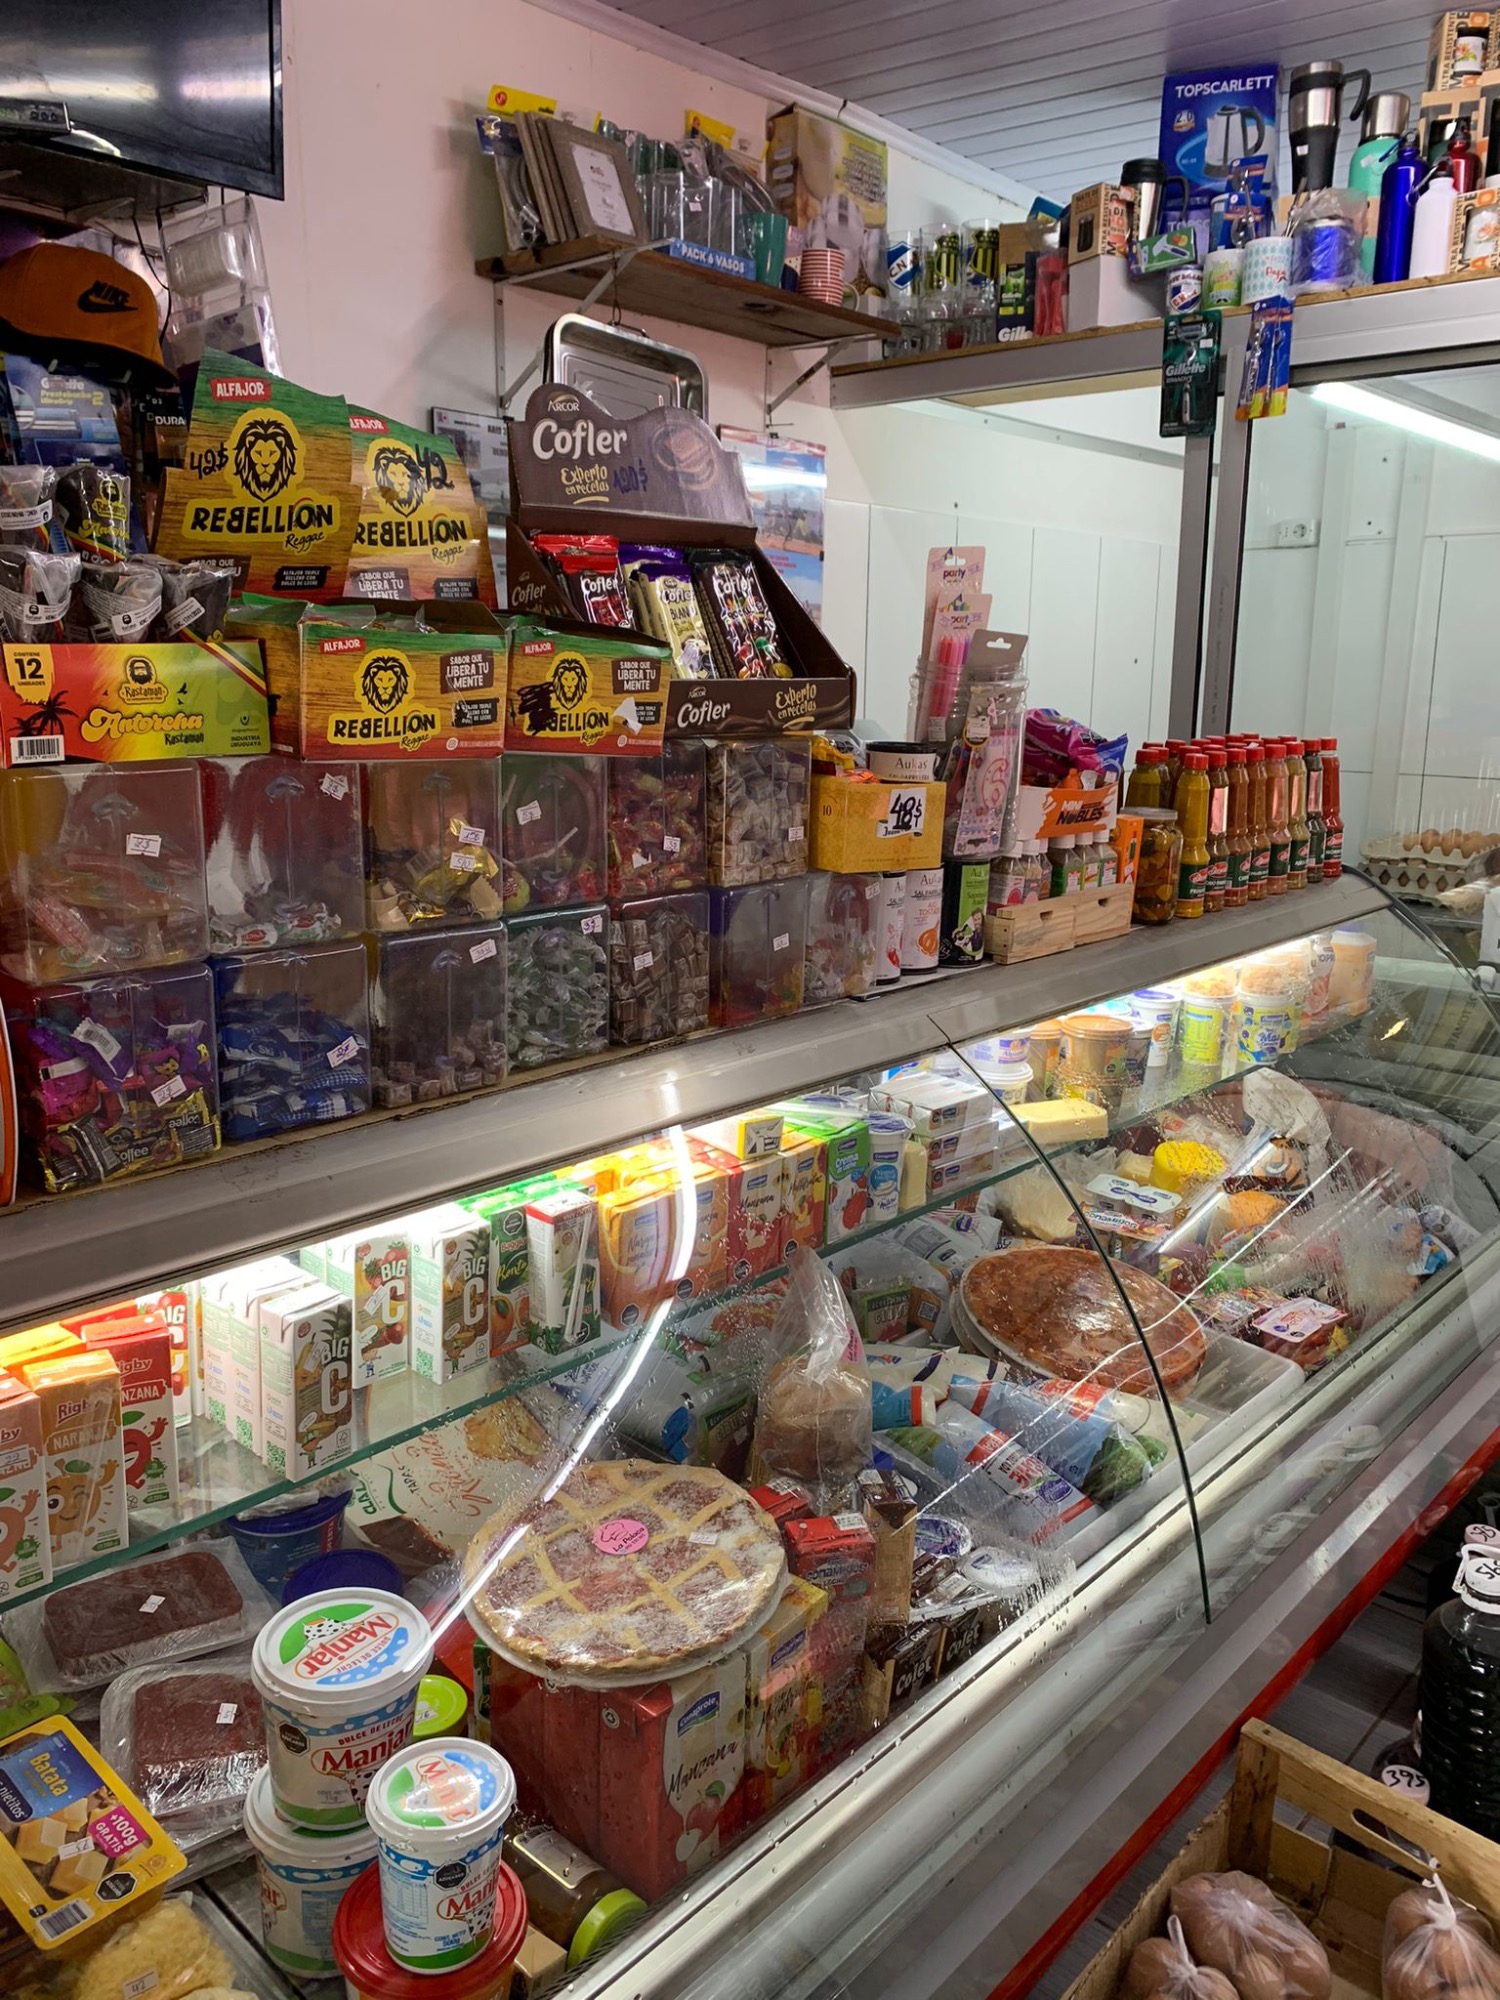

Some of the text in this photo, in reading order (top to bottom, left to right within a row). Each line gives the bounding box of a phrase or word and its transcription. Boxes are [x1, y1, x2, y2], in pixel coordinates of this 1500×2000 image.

[1175, 75, 1273, 98] TOPSCARLETT
[682, 245, 745, 273] PACK 6 VASOS
[1166, 364, 1206, 376] Gillette
[216, 382, 265, 397] ALFAJOR
[548, 400, 580, 412] ARCOR
[533, 419, 627, 461] Cofler
[190, 442, 229, 480] 42$
[561, 464, 608, 485] Experto
[565, 480, 610, 495] en recetas
[191, 504, 333, 534] REBELLION
[285, 531, 326, 553] Reggae
[353, 519, 468, 548] REBELLION
[218, 558, 234, 567] QUE
[431, 545, 464, 566] Reggae
[359, 571, 396, 581] SABOR QUE
[943, 568, 966, 579] party
[358, 580, 404, 592] LIBERA TU
[511, 584, 546, 606] Cofler
[583, 576, 618, 593] Cofler
[661, 588, 695, 604] Cofler
[324, 638, 361, 652] ALFAJOR
[524, 643, 552, 654] ALFAJOR
[14, 658, 44, 680] 12
[449, 653, 483, 665] SABOR QUE
[446, 662, 489, 678] LIBERA TU
[618, 669, 656, 680] LIBERA TU
[124, 686, 163, 698] Rastaman
[454, 675, 484, 689] MENTE
[624, 680, 650, 691] MENTE
[776, 682, 817, 707] Experto
[677, 701, 731, 728] Cofler
[778, 702, 817, 719] en recetas
[81, 708, 203, 742] Antorcha
[333, 714, 436, 739] REBELLION
[540, 712, 609, 732] BELLION
[164, 733, 204, 746] Rastaman
[401, 733, 430, 750] Reggae
[581, 730, 605, 742] Reggae
[895, 757, 928, 770] Aukas
[822, 804, 832, 817] 10
[119, 1145, 149, 1163] offee
[380, 1259, 407, 1281] BIG
[463, 1256, 486, 1281] BIG
[382, 1279, 406, 1325] C
[463, 1278, 485, 1326] C
[321, 1337, 349, 1364] BIG
[321, 1361, 349, 1415] C
[612, 1542, 624, 1553] La
[622, 1527, 646, 1545] Polaca
[302, 1615, 393, 1676] Manjar
[895, 1655, 932, 1697] Colet
[321, 1719, 414, 1772] Manjar
[338, 1732, 367, 1746] DULCE
[370, 1725, 382, 1735] DE
[30, 1752, 69, 1796] Batata
[667, 1740, 739, 1799] Manzana
[1386, 1769, 1427, 1788] 395
[96, 1822, 124, 1853] GRATIS
[110, 1814, 139, 1847] +100g
[460, 1877, 481, 1892] DULCE
